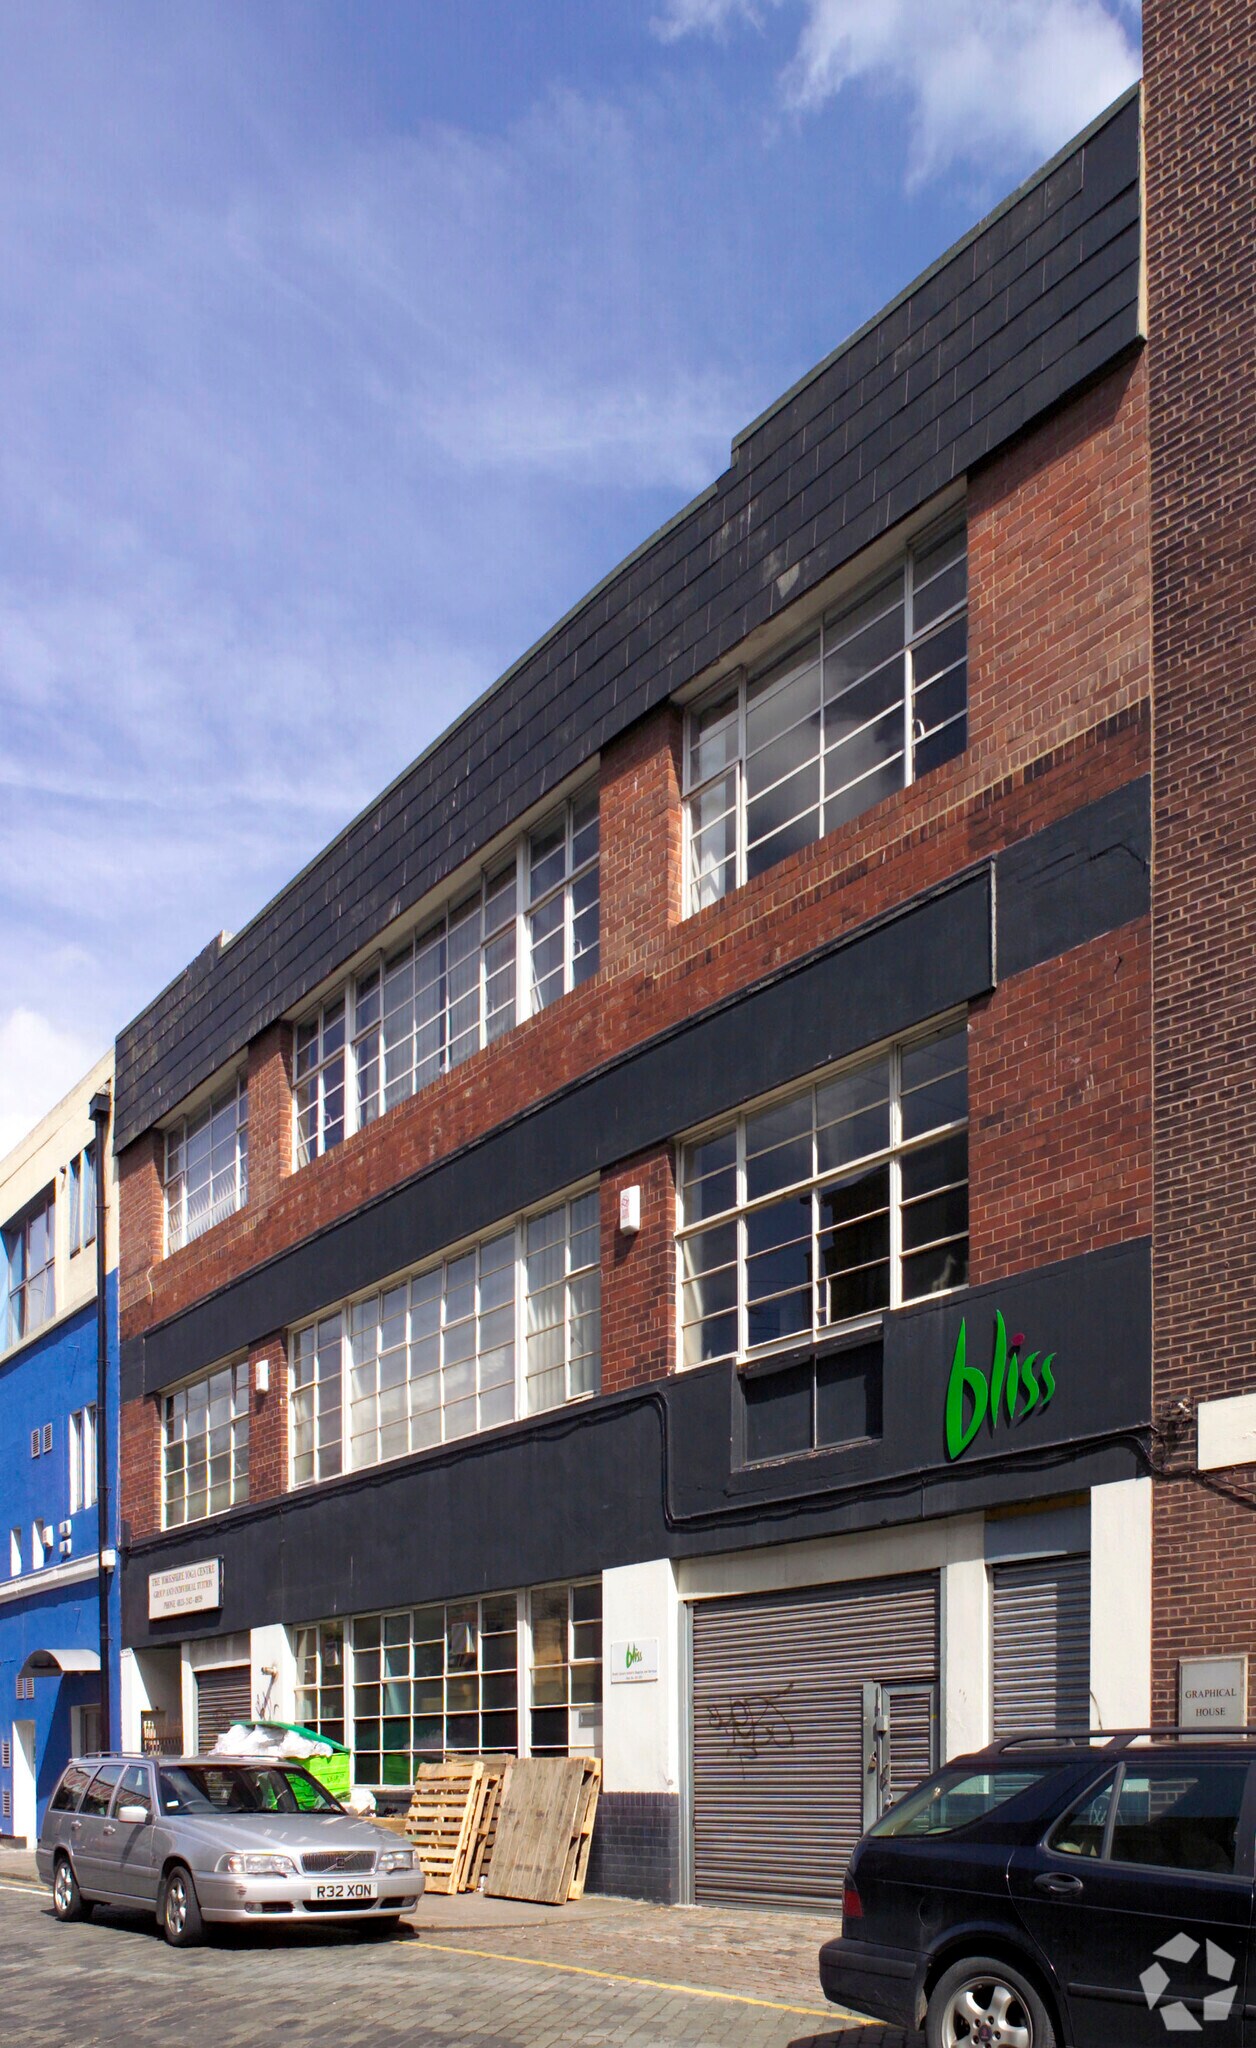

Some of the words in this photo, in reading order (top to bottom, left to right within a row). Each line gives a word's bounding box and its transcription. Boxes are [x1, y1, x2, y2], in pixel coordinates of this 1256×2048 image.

[946, 1309, 1057, 1460] bliss
[197, 1564, 215, 1577] CENTRE
[626, 1642, 643, 1669] bliss
[1185, 1687, 1237, 1699] GRAPHICAL
[1195, 1707, 1226, 1717] HOUSE
[317, 1885, 344, 1898] R32
[347, 1884, 372, 1897] XON
